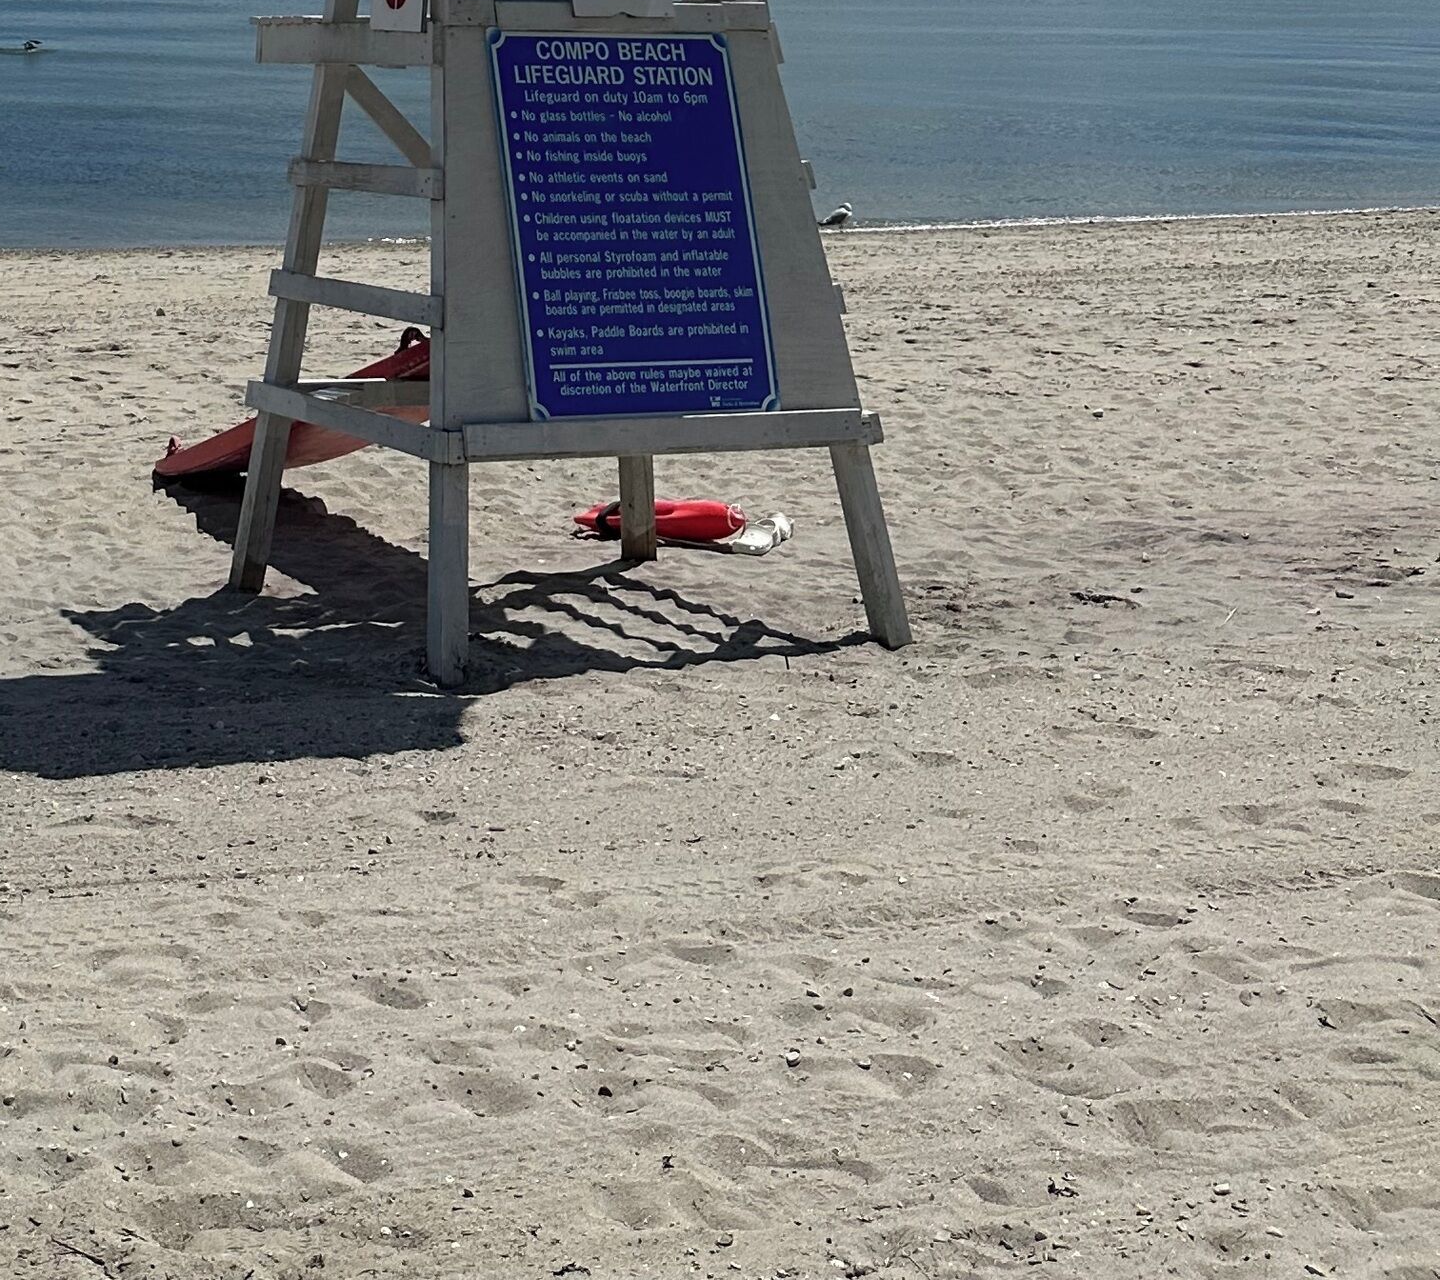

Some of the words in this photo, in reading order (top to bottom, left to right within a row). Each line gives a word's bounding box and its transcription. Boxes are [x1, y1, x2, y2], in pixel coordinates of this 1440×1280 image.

[536, 41, 609, 60] COMPO
[618, 43, 686, 61] BEACH
[514, 65, 624, 85] LIFEGUARD
[634, 67, 713, 86] STATION
[525, 90, 579, 104] Lifeguard
[585, 93, 598, 102] on
[603, 92, 628, 104] duty
[633, 92, 662, 103] 10am
[668, 93, 679, 103] to
[683, 92, 708, 105] 6pm
[522, 111, 535, 121] No
[540, 111, 566, 123] glass
[570, 111, 605, 121] bottles
[619, 111, 632, 122] No
[637, 111, 672, 122] alcohol
[524, 132, 538, 142] No
[543, 132, 580, 142] animals
[585, 134, 596, 142] on
[601, 132, 617, 142] the
[621, 132, 651, 142] beach
[527, 150, 540, 161] No
[545, 151, 579, 163] fishing
[584, 151, 613, 161] inside
[617, 151, 647, 163] buoys
[529, 172, 543, 183] No
[548, 172, 585, 183] athletic
[590, 173, 623, 183] events
[628, 174, 640, 182] on
[644, 172, 668, 182] sand
[532, 192, 546, 202] No
[550, 192, 601, 203] snorkeling
[605, 194, 614, 202] or
[619, 192, 648, 202] scuba
[653, 192, 687, 201] without
[693, 192, 698, 201] a
[702, 191, 732, 203] permit
[535, 213, 576, 224] Children
[581, 214, 607, 226] using
[612, 212, 660, 223] floatation
[665, 212, 701, 222] devices
[705, 212, 731, 222] MUST
[537, 230, 549, 240] be
[553, 230, 616, 242] accompanied
[620, 230, 629, 240] in
[633, 230, 648, 239] the
[652, 229, 677, 239] water
[682, 229, 693, 241] by
[697, 230, 708, 238] an
[712, 228, 735, 239] adult
[540, 252, 553, 263] All
[557, 251, 601, 264] personal
[605, 251, 656, 264] Styrofoam
[661, 251, 678, 261] and
[683, 250, 728, 261] inflatable
[542, 268, 581, 279] bubbles
[585, 268, 602, 278] are
[607, 267, 657, 279] prohibited
[661, 267, 669, 277] in
[674, 267, 689, 276] the
[694, 266, 721, 276] water
[544, 290, 561, 301] Ball
[603, 289, 636, 300] Frisbee
[664, 288, 694, 300] boogie
[734, 287, 753, 297] skim
[546, 305, 577, 315] boards
[581, 305, 596, 315] are
[600, 303, 643, 316] permitted
[647, 304, 655, 313] in
[659, 302, 707, 315] designated
[711, 302, 735, 311] areas
[592, 326, 625, 338] Paddle
[629, 325, 664, 337] Boards
[668, 326, 683, 336] are
[688, 324, 736, 337] prohibited
[740, 324, 748, 334] in
[551, 346, 576, 357] swim
[580, 346, 603, 355] area
[553, 371, 565, 382] All
[570, 371, 581, 381] of
[585, 370, 601, 381] the
[606, 369, 636, 380] above
[640, 368, 664, 379] rules
[669, 368, 701, 380] maybe
[705, 367, 738, 378] waived
[742, 366, 752, 376] at
[560, 384, 611, 396] discretion
[615, 384, 626, 394] of
[630, 383, 646, 393] the
[650, 381, 704, 392] Waterfront
[708, 379, 748, 390] Director
